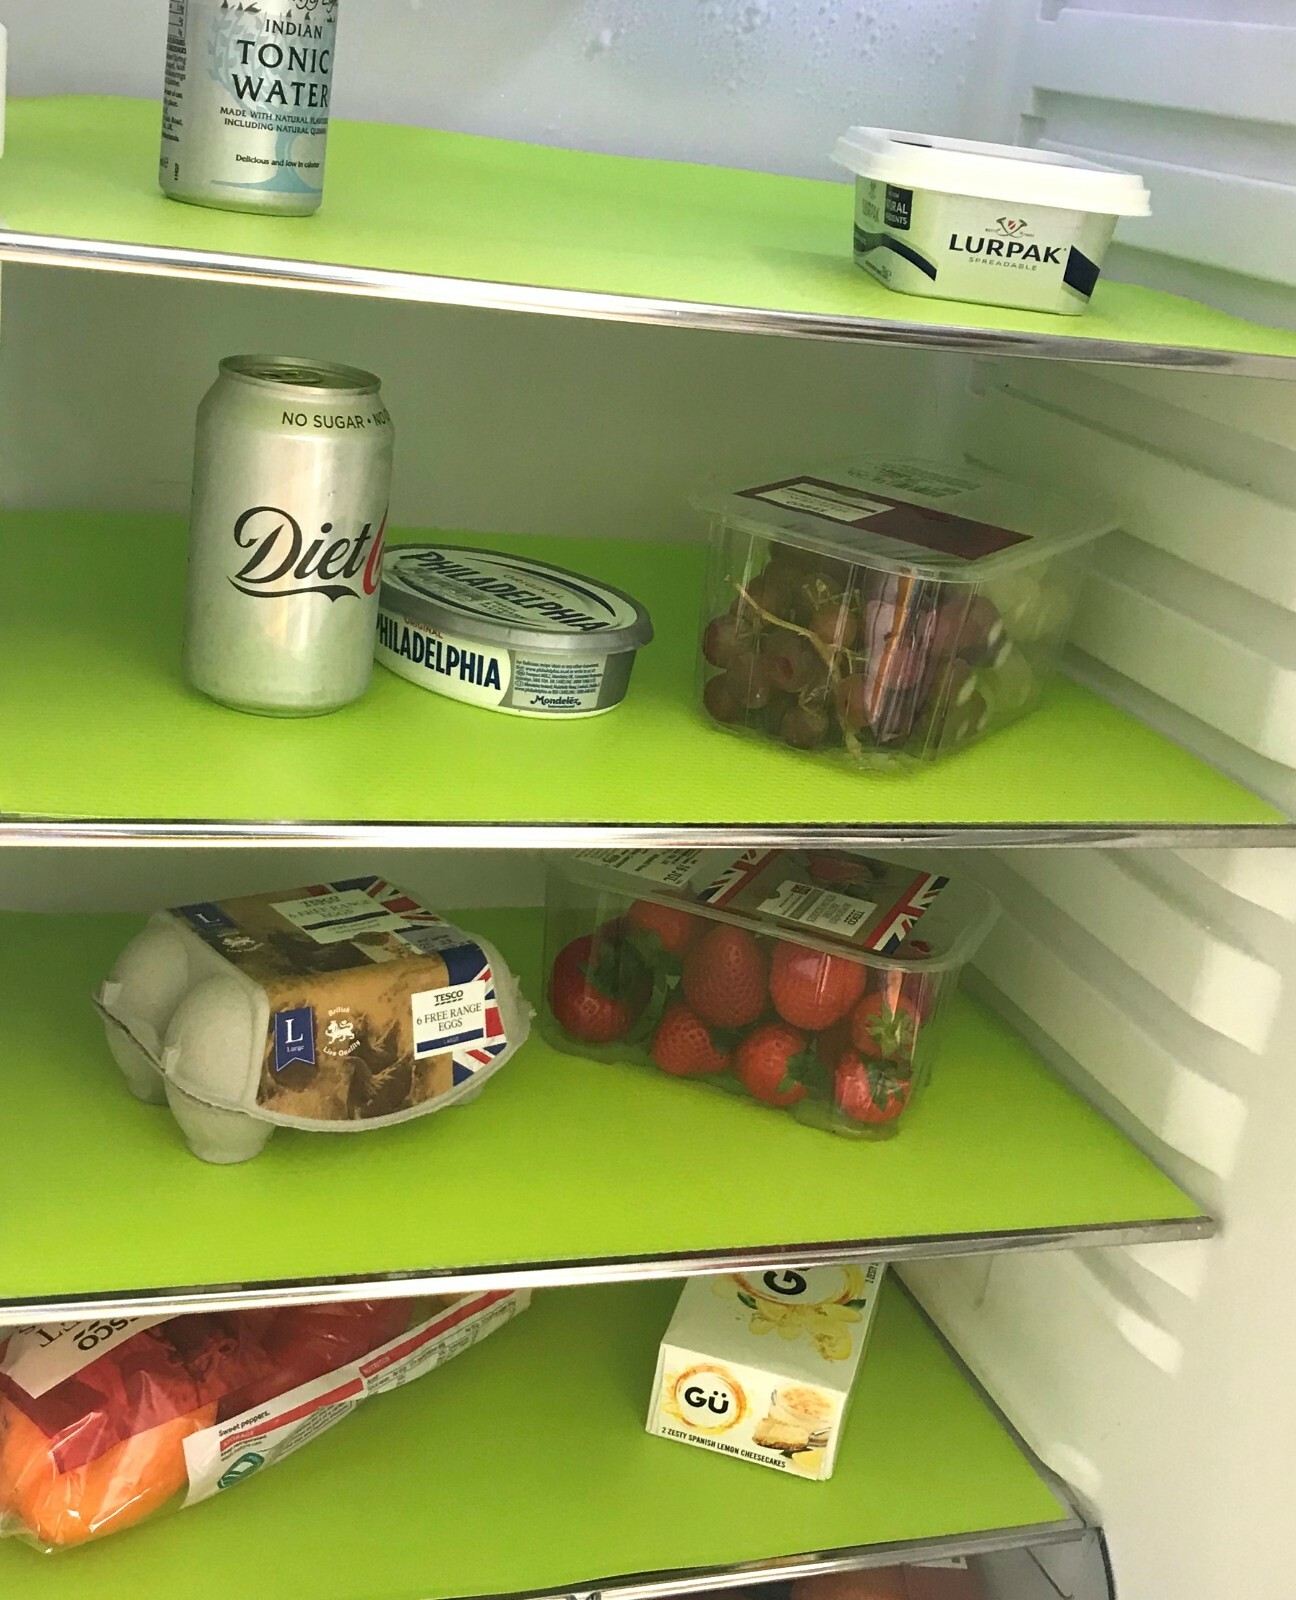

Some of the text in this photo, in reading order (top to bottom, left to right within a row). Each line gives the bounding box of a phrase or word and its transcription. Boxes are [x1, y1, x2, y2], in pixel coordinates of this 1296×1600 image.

[265, 19, 322, 39] INDIAN
[237, 39, 330, 74] TONIC
[231, 73, 328, 108] WATER
[220, 106, 246, 117] MADE
[250, 111, 272, 120] WITH
[275, 114, 308, 124] NATURAL
[224, 118, 274, 131] INCLUDING
[276, 125, 309, 134] NATURAL
[235, 154, 269, 165] Delicious
[271, 159, 283, 167] and
[949, 233, 1062, 264] LURPAK
[968, 257, 1037, 271] SPREADABLE
[282, 411, 308, 426] NO
[313, 415, 365, 428] SUGAR
[234, 506, 371, 584] Diet
[399, 551, 611, 632] PHILADELPHIA
[503, 574, 564, 599] ORIGINAL
[404, 617, 443, 639] ORIGINAL
[847, 911, 865, 926] TESCO
[434, 990, 464, 1002] TESCO
[416, 1003, 482, 1025] 6 FREE RANGE
[438, 1018, 463, 1031] EGGS
[285, 1018, 304, 1044] L
[78, 1317, 139, 1350] SCO
[684, 1386, 729, 1415] Gü
[218, 1410, 270, 1437] Sweet peppers.
[661, 1426, 786, 1468] 2 ZESTY SPANISH LEMON CHEESECAKES
